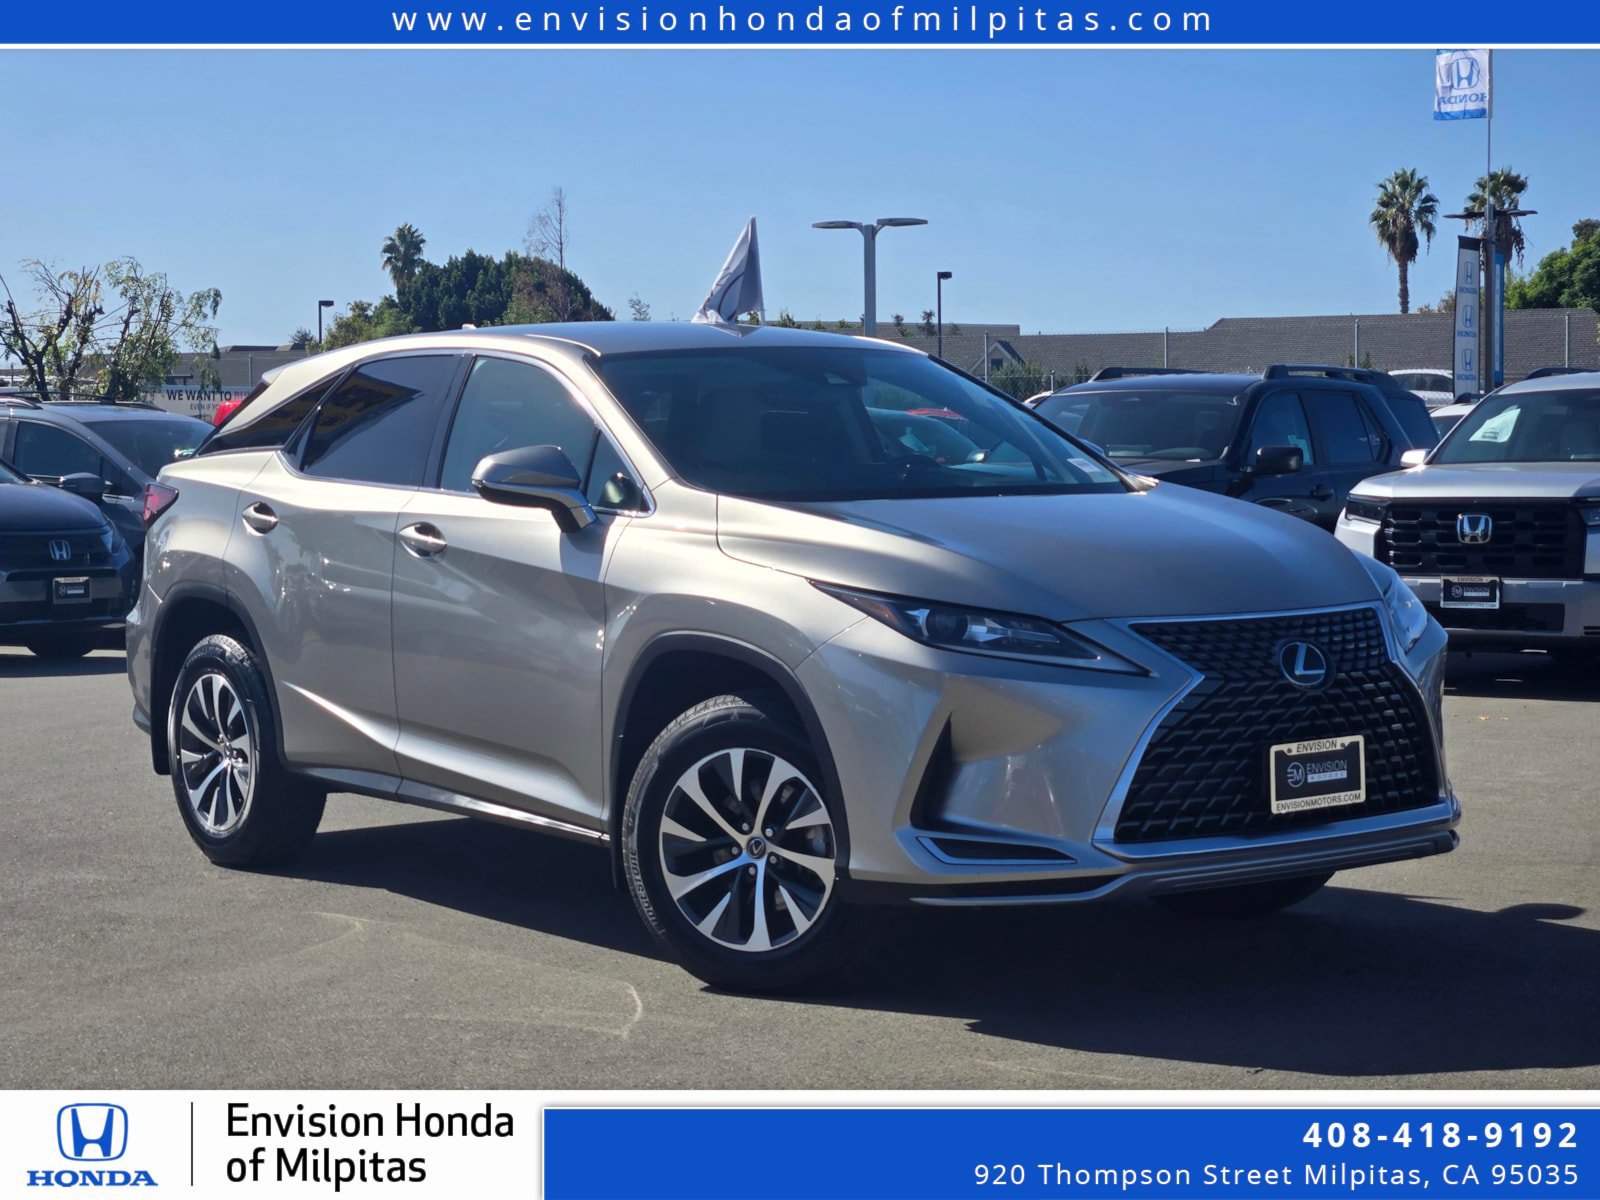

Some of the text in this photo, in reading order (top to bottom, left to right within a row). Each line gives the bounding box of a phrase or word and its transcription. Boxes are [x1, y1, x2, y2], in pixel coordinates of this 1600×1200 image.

[166, 389, 183, 401] WE
[186, 389, 216, 401] WANT
[219, 391, 232, 401] TO
[1296, 739, 1338, 753] ENVISION
[1306, 760, 1347, 775] ENVISION
[1276, 793, 1362, 812] ENVISIONMOTORS.COM
